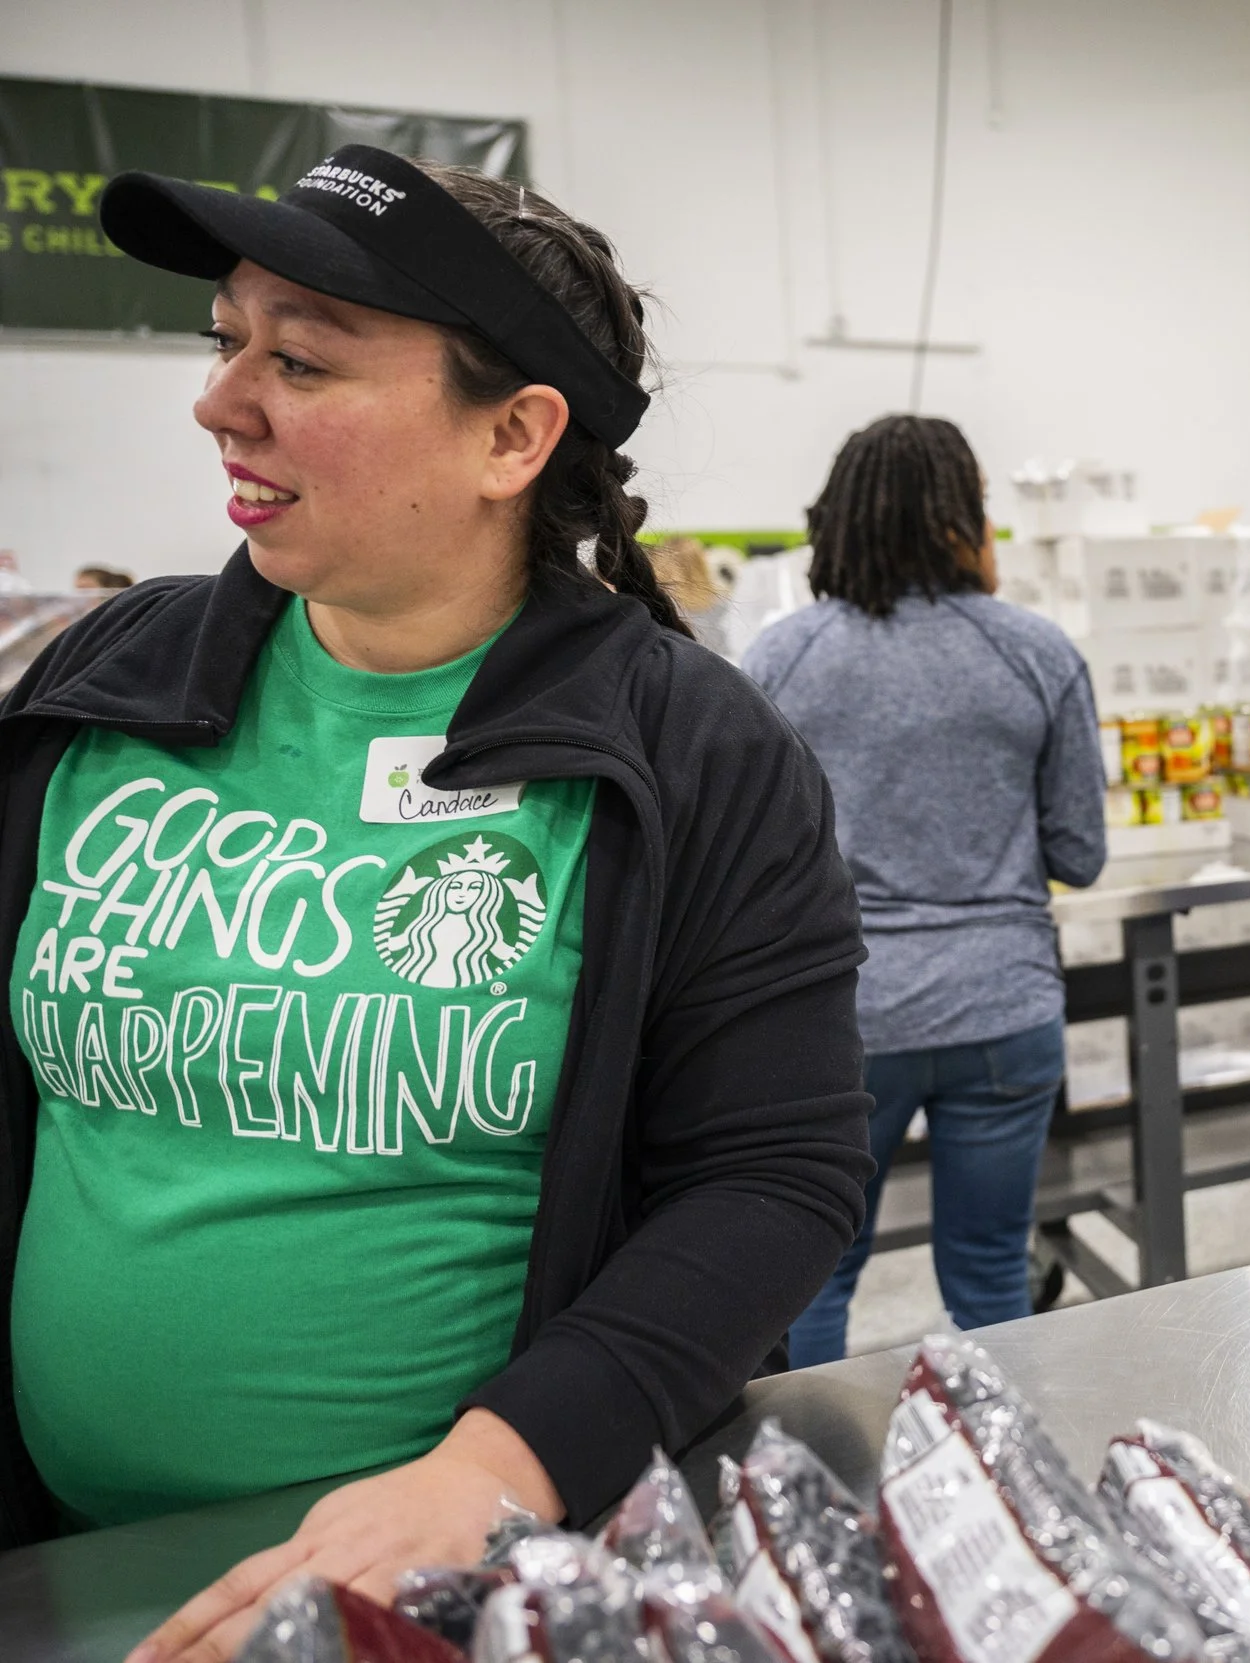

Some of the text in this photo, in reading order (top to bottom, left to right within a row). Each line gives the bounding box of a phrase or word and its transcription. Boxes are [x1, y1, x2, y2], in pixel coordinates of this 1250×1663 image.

[3, 169, 107, 216] RY
[296, 177, 388, 216] FOUNDATION
[24, 222, 124, 257] CHIL
[64, 778, 327, 888] GOOD
[399, 788, 499, 820] Candace
[43, 855, 387, 978] THINGS
[29, 928, 149, 999] ARE
[22, 983, 536, 1156] HAPPENING
